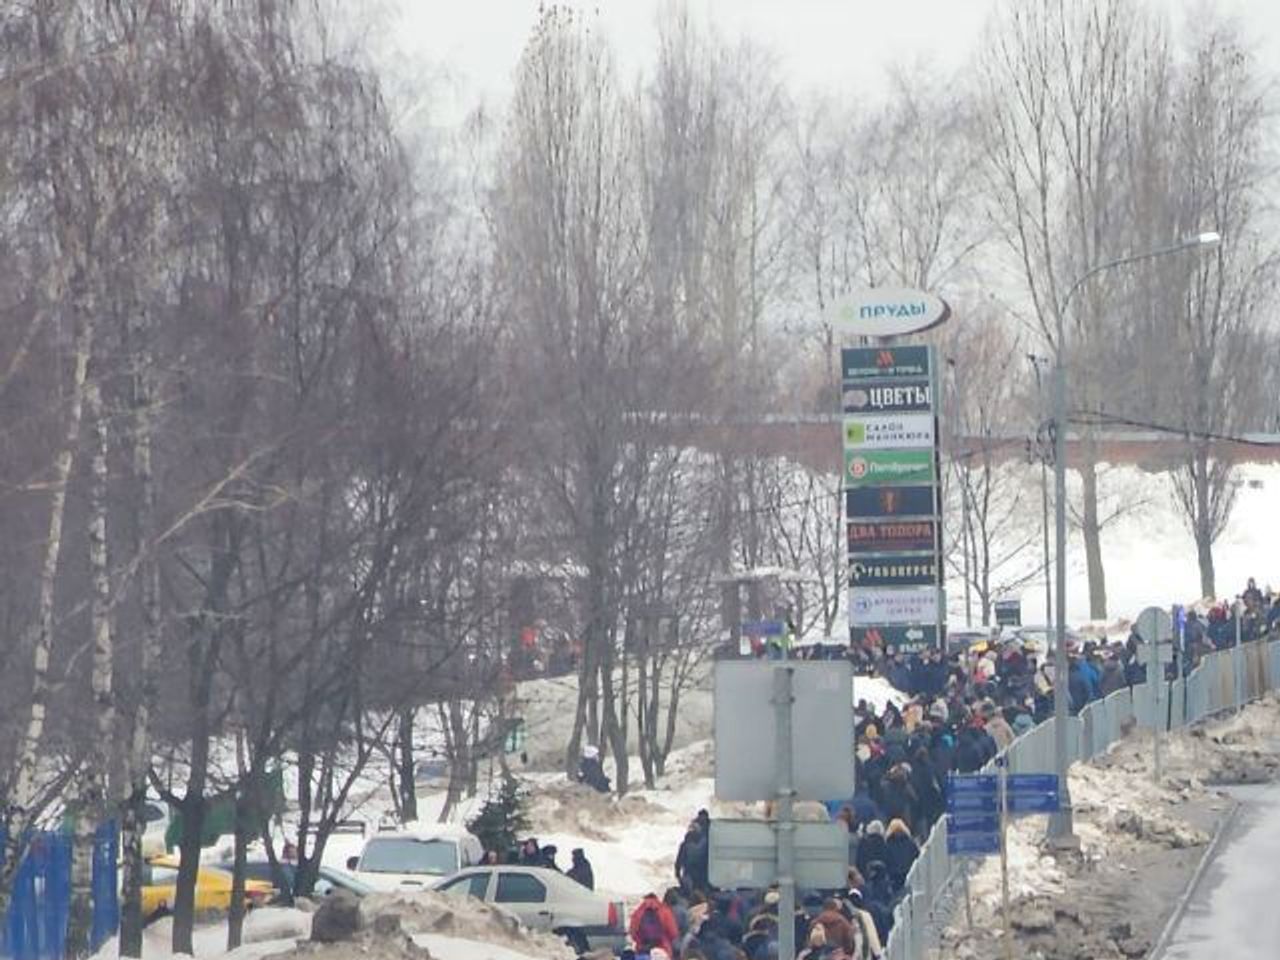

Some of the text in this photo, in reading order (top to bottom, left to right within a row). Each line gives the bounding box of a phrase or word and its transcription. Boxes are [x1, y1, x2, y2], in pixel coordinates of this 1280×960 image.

[859, 302, 926, 319] ПРУДЫ
[870, 386, 932, 409] ЦВЕТЫ
[849, 524, 931, 539] ДВА ТОПОРА
